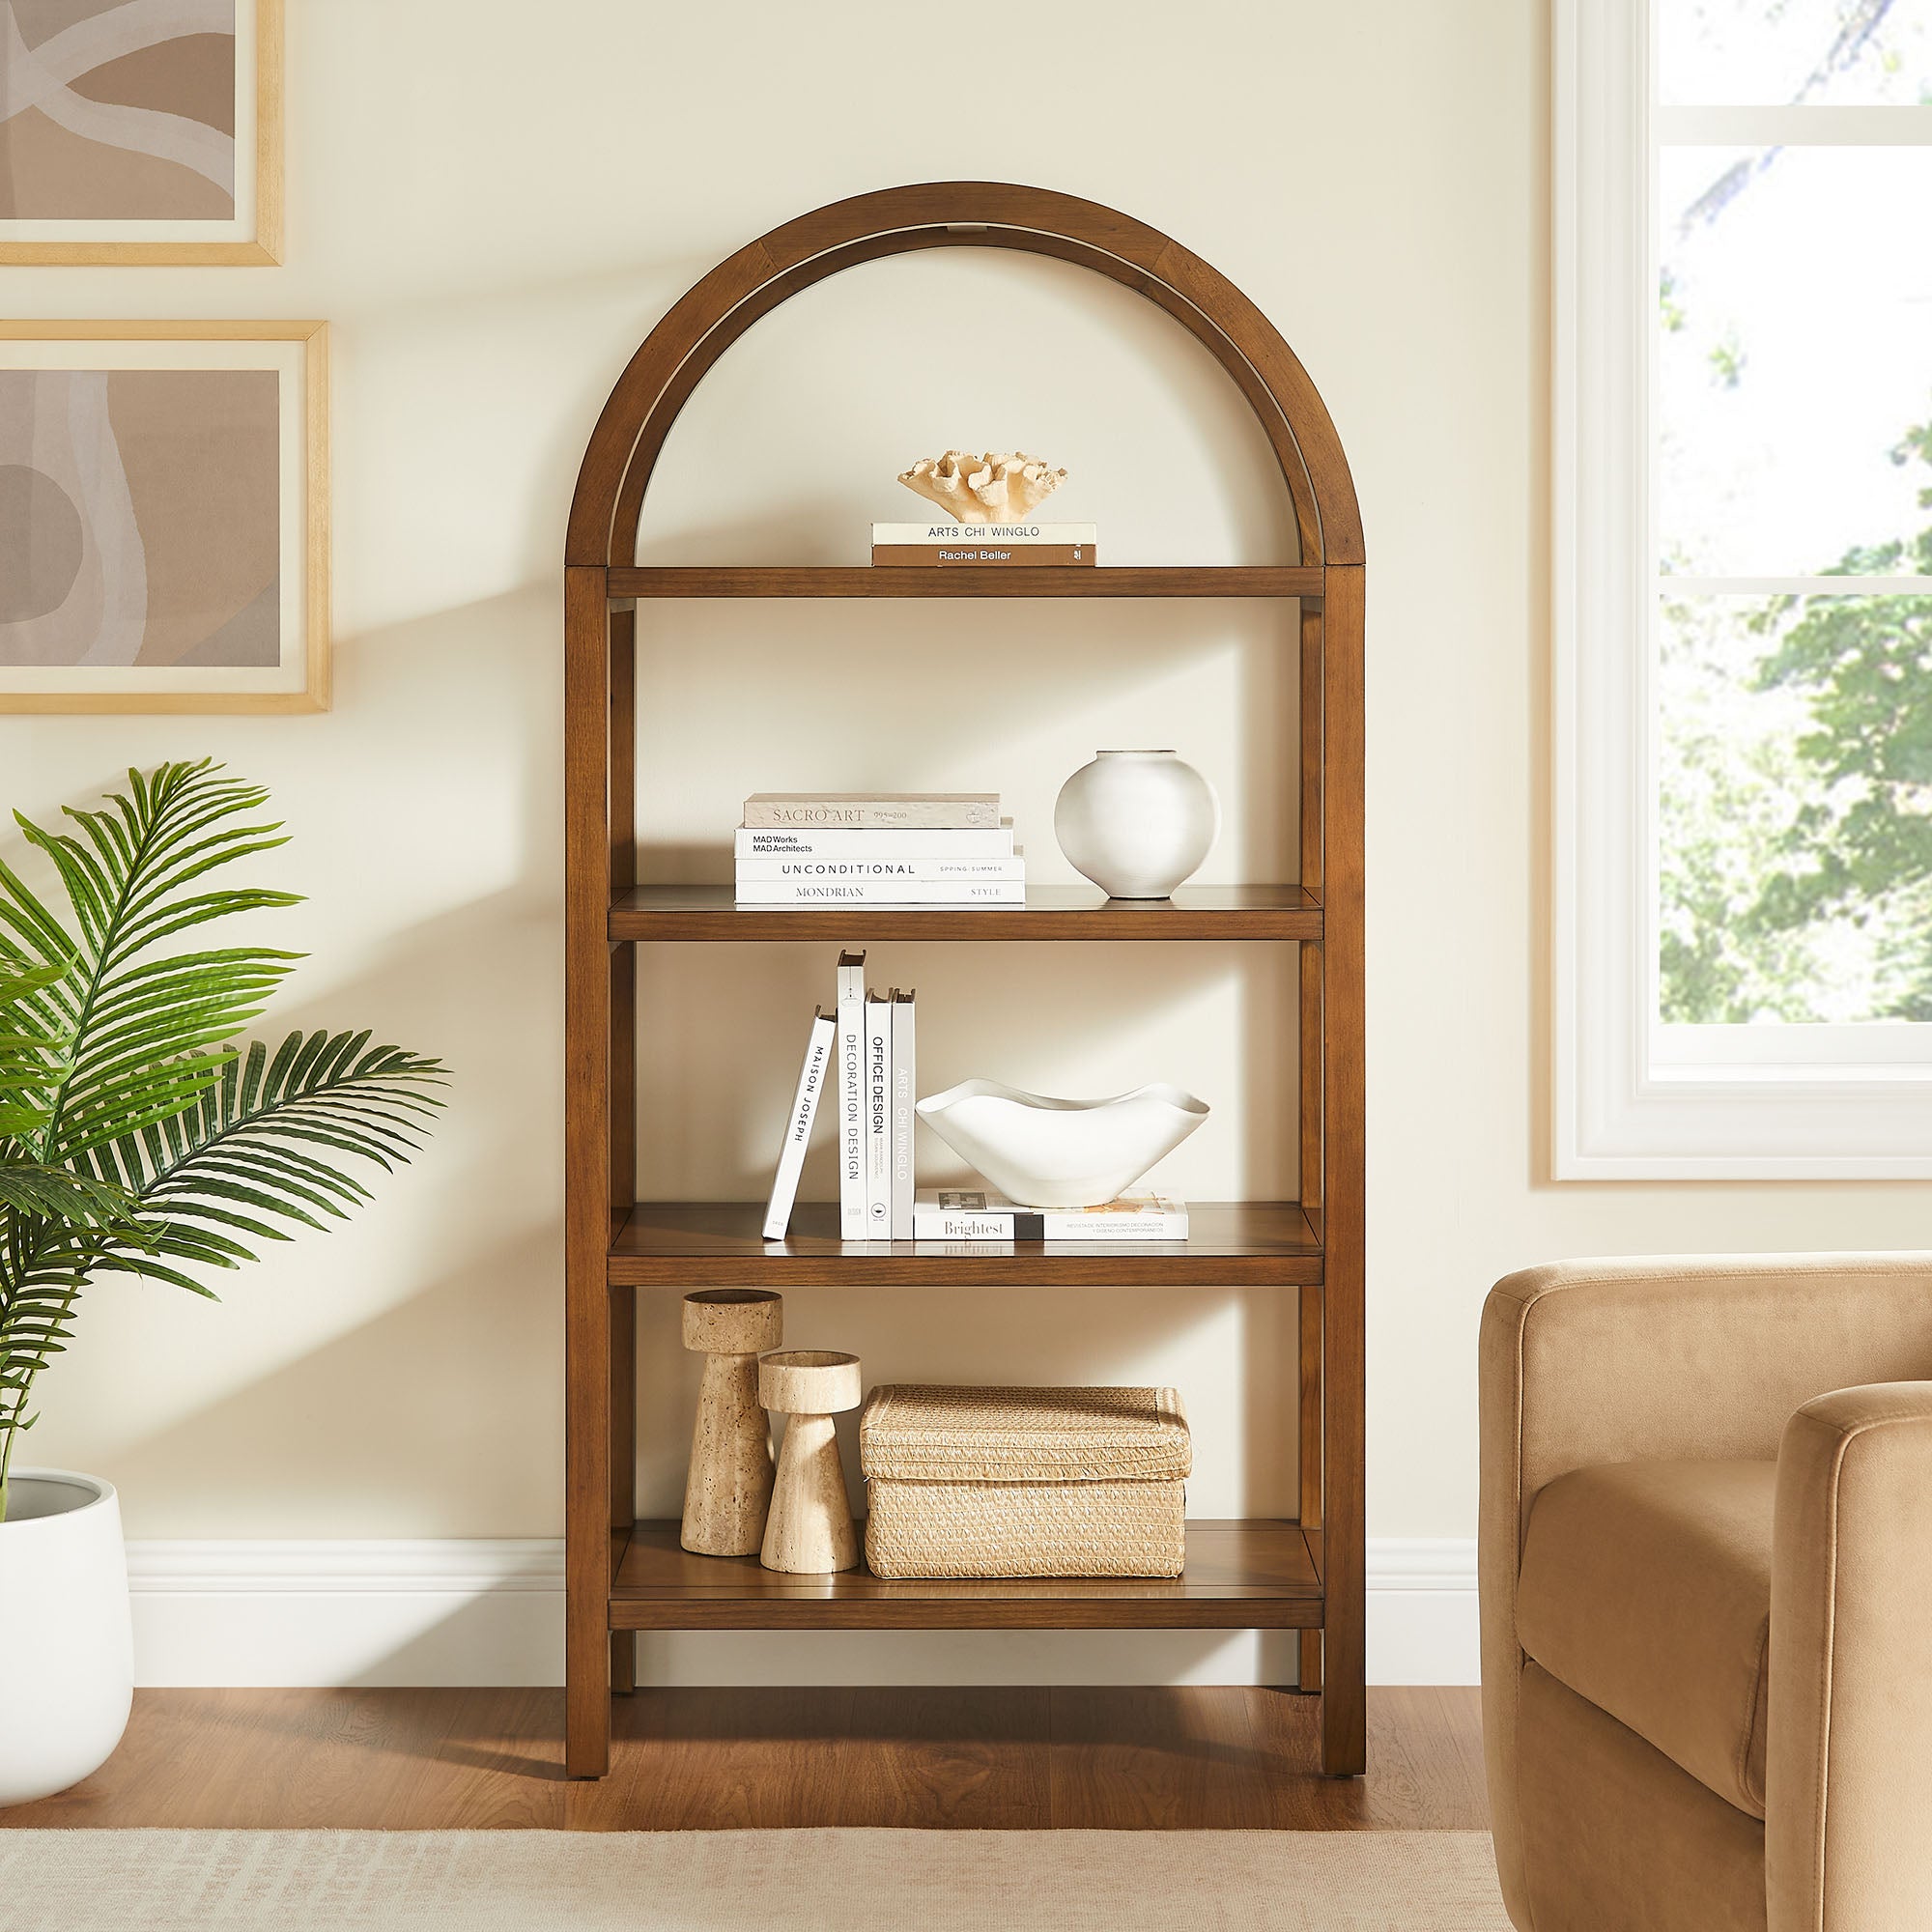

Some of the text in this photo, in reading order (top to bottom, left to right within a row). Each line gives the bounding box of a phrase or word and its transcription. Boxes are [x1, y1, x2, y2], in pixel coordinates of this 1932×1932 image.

[928, 526, 1039, 537] ARTS CHI WINGLO
[939, 551, 1011, 560] Rachel Beller
[773, 810, 827, 821] SACRO
[833, 810, 865, 821] ART
[781, 865, 915, 874] UNCONDITIONAL
[796, 888, 864, 896] MONDRIAN
[872, 1037, 883, 1083] OFFICE
[795, 1046, 823, 1142] MAISON JOSEPH
[846, 1035, 859, 1179] DECORATION DESIGN
[873, 1087, 883, 1134] DESIGN
[897, 1067, 908, 1180] ARTS CHI WINGLO
[944, 1221, 1003, 1238] Brightest
